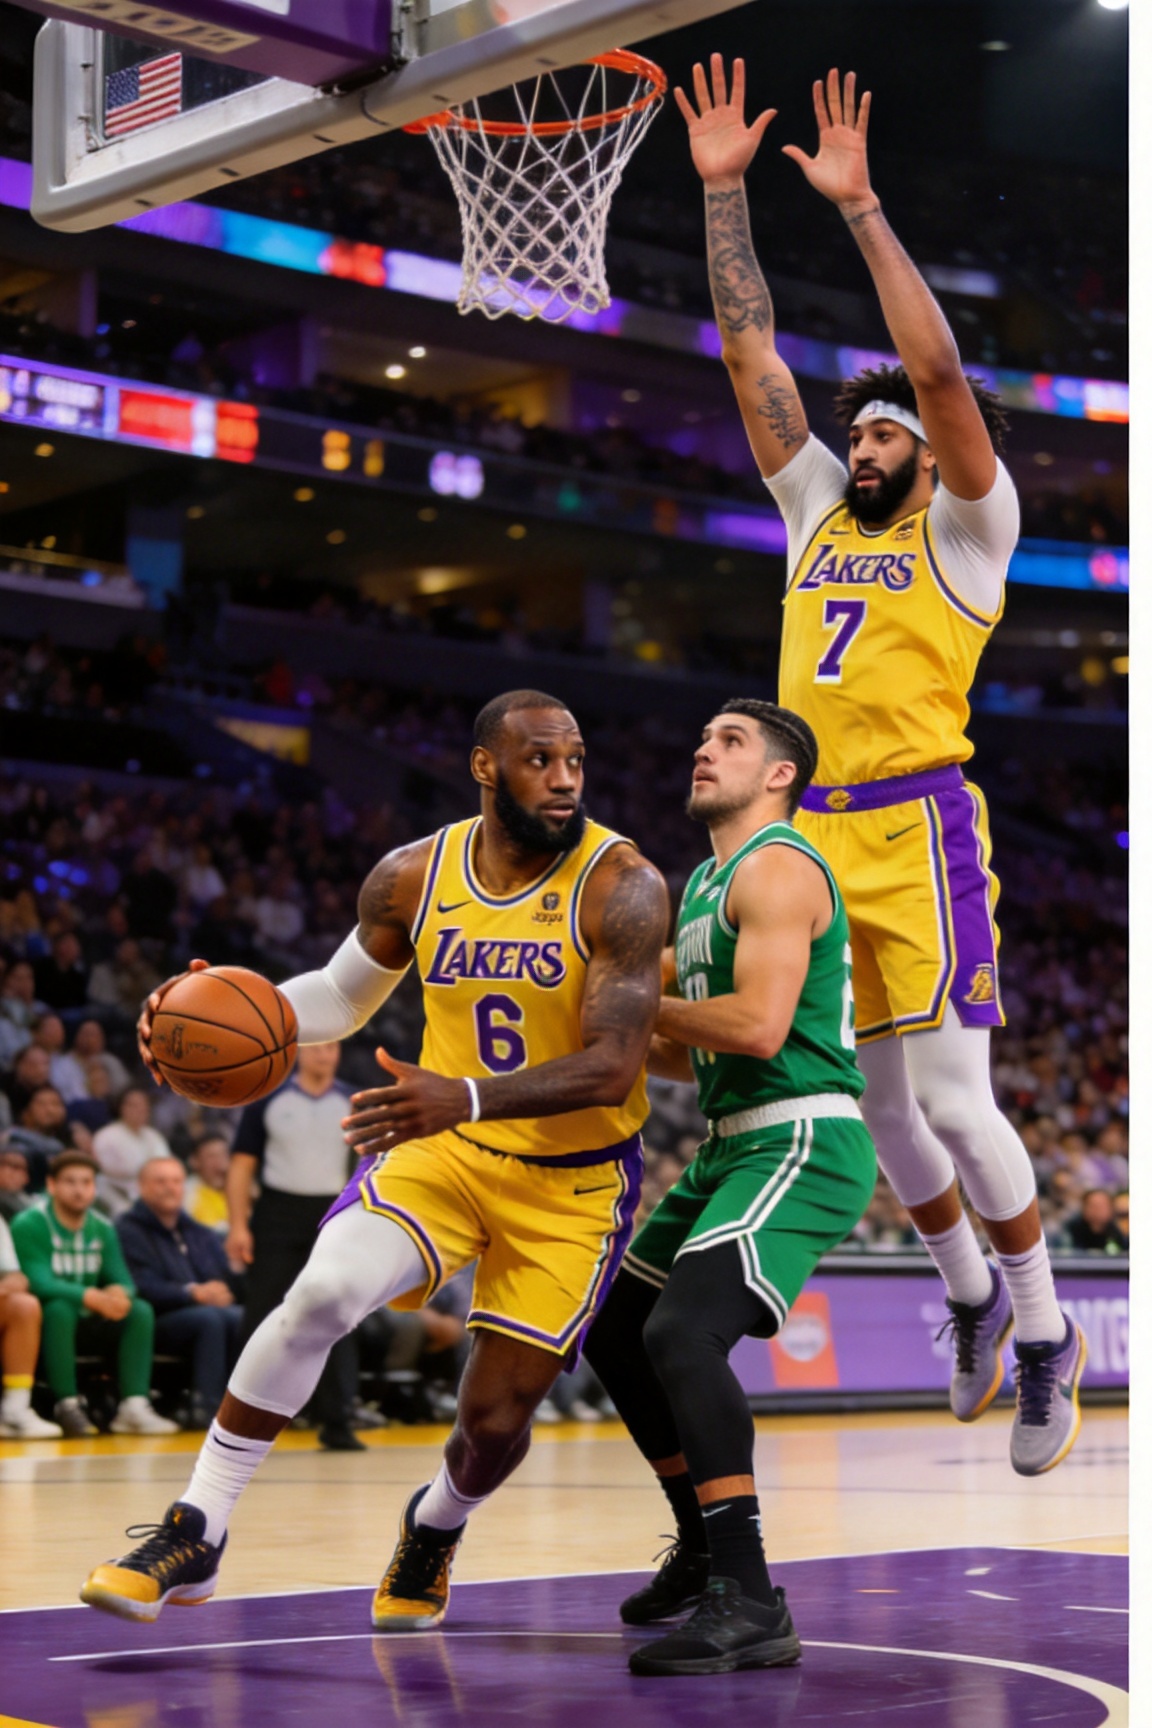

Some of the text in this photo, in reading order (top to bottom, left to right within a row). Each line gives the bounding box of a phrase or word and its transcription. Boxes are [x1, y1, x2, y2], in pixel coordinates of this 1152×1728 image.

[797, 544, 916, 593] LAKERS
[814, 599, 867, 684] 7
[424, 927, 567, 991] LAKERS
[472, 993, 528, 1076] 6
